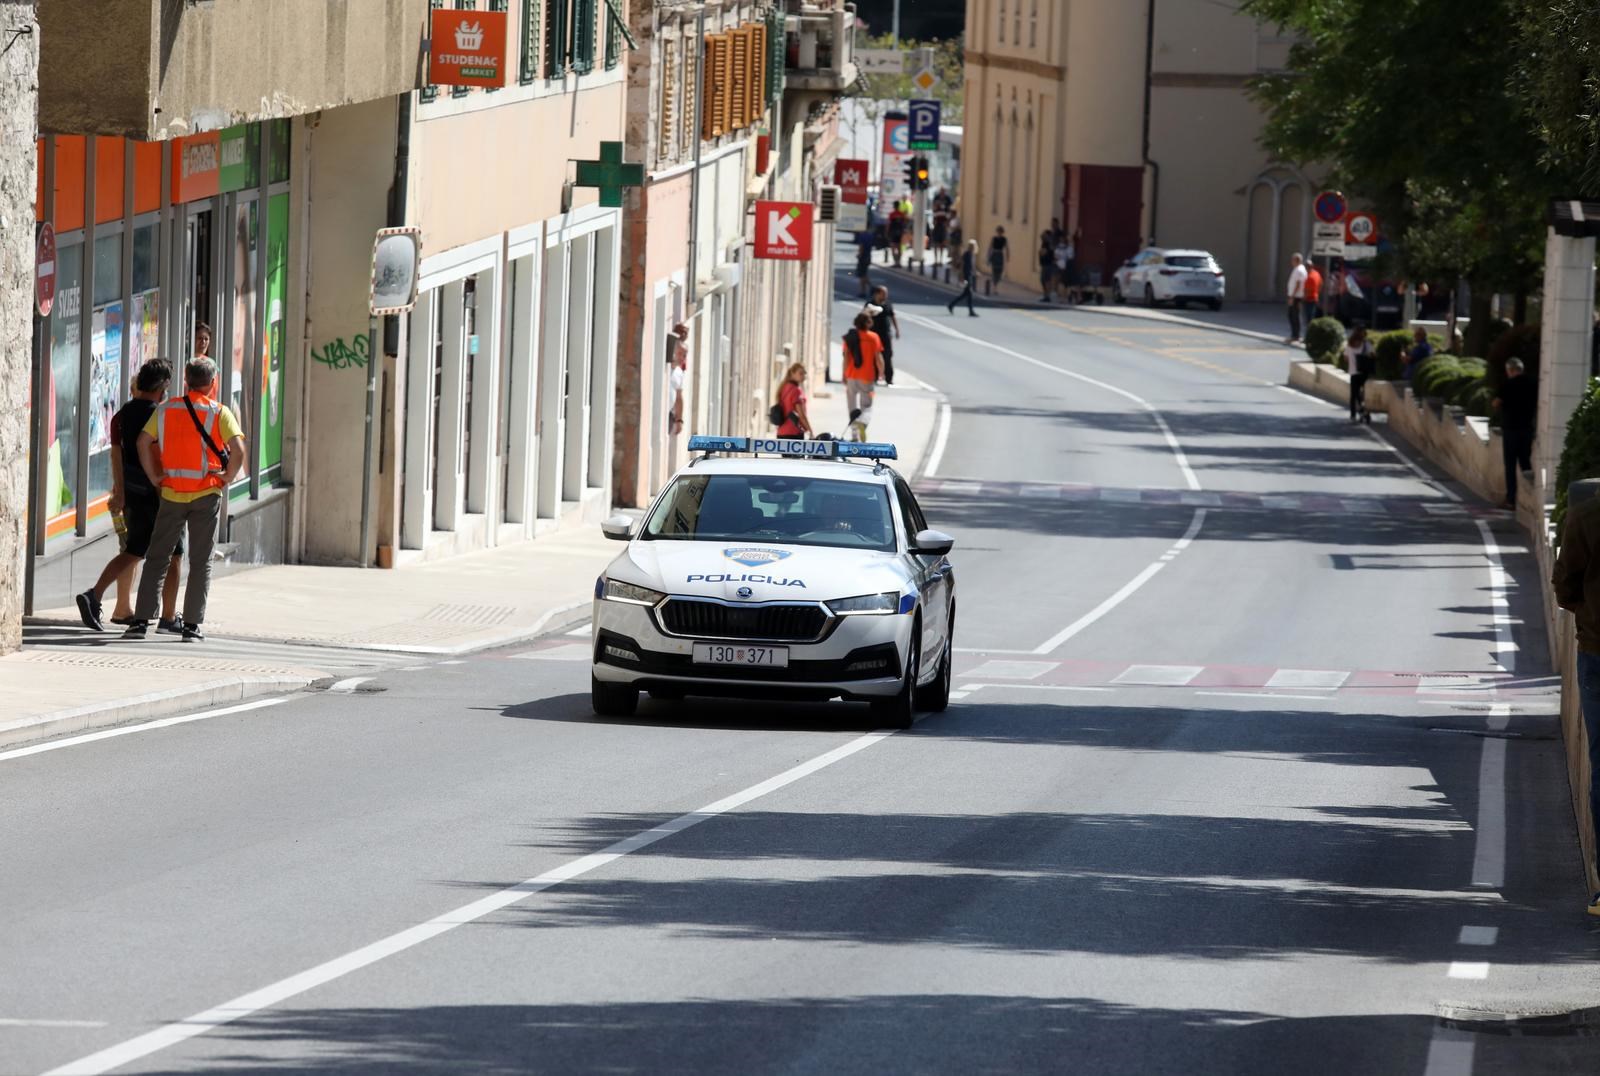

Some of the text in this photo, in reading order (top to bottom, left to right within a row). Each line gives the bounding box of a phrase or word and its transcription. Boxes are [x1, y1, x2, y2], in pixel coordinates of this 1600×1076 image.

[439, 54, 498, 66] STUDENAC
[462, 68, 496, 77] MARKET
[917, 110, 934, 132] P
[768, 206, 799, 246] K
[767, 246, 799, 256] market
[753, 440, 827, 454] POLICIJA
[686, 574, 807, 588] POLICIJA
[708, 646, 774, 664] 130 371
